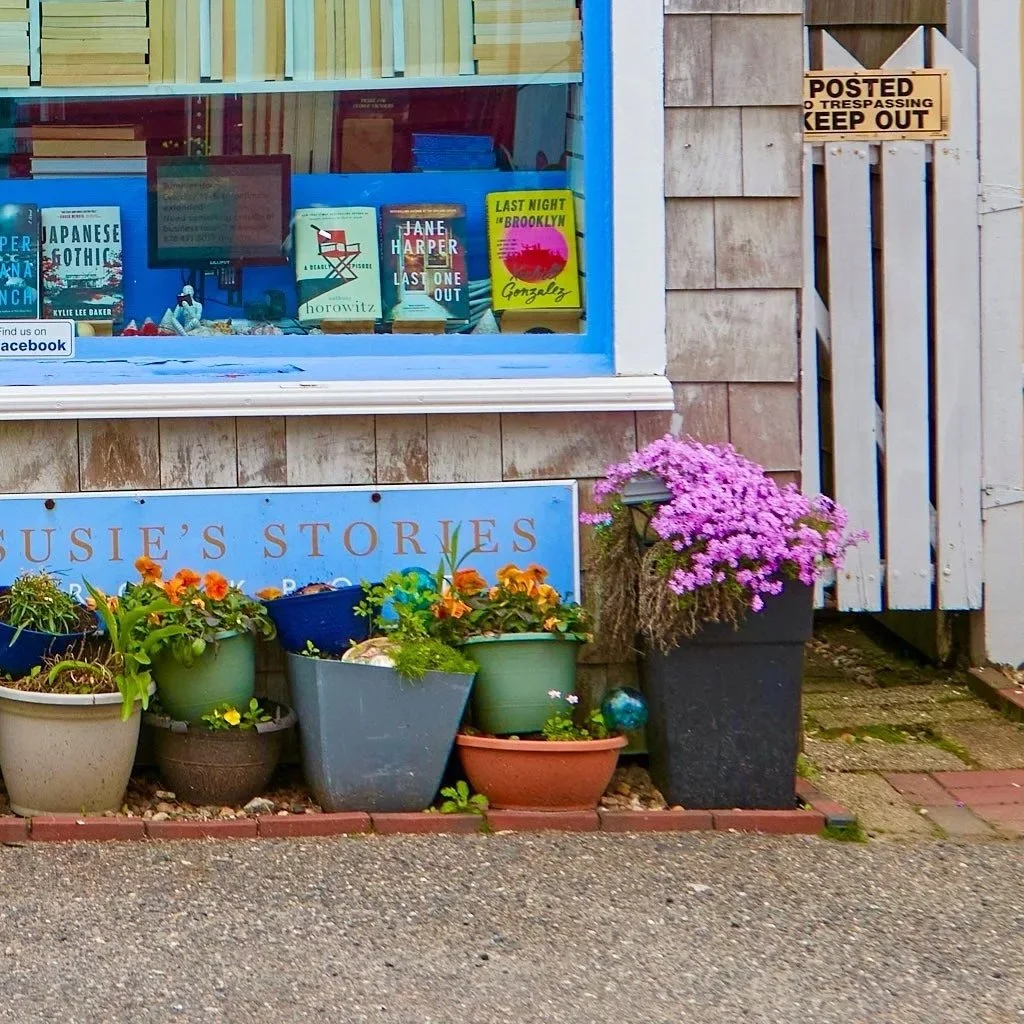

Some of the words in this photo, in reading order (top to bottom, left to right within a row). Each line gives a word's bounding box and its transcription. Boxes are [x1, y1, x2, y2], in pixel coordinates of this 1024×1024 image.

[810, 78, 913, 98] POSTED
[820, 99, 933, 109] TRESPASSING
[876, 110, 928, 129] OUT
[496, 200, 524, 212] LAST
[529, 199, 566, 210] NIGHT
[404, 221, 444, 236] JANE
[505, 215, 565, 228] BROOKLYN
[42, 224, 119, 244] JAPANESE
[392, 240, 457, 254] HARPER
[52, 248, 110, 266] GOTHIC
[394, 272, 426, 285] LAST
[434, 272, 460, 285] ONE
[435, 289, 461, 301] OUT
[502, 282, 572, 304] Gonzalez
[307, 301, 375, 314] horowitz
[264, 518, 537, 558] STORIES
